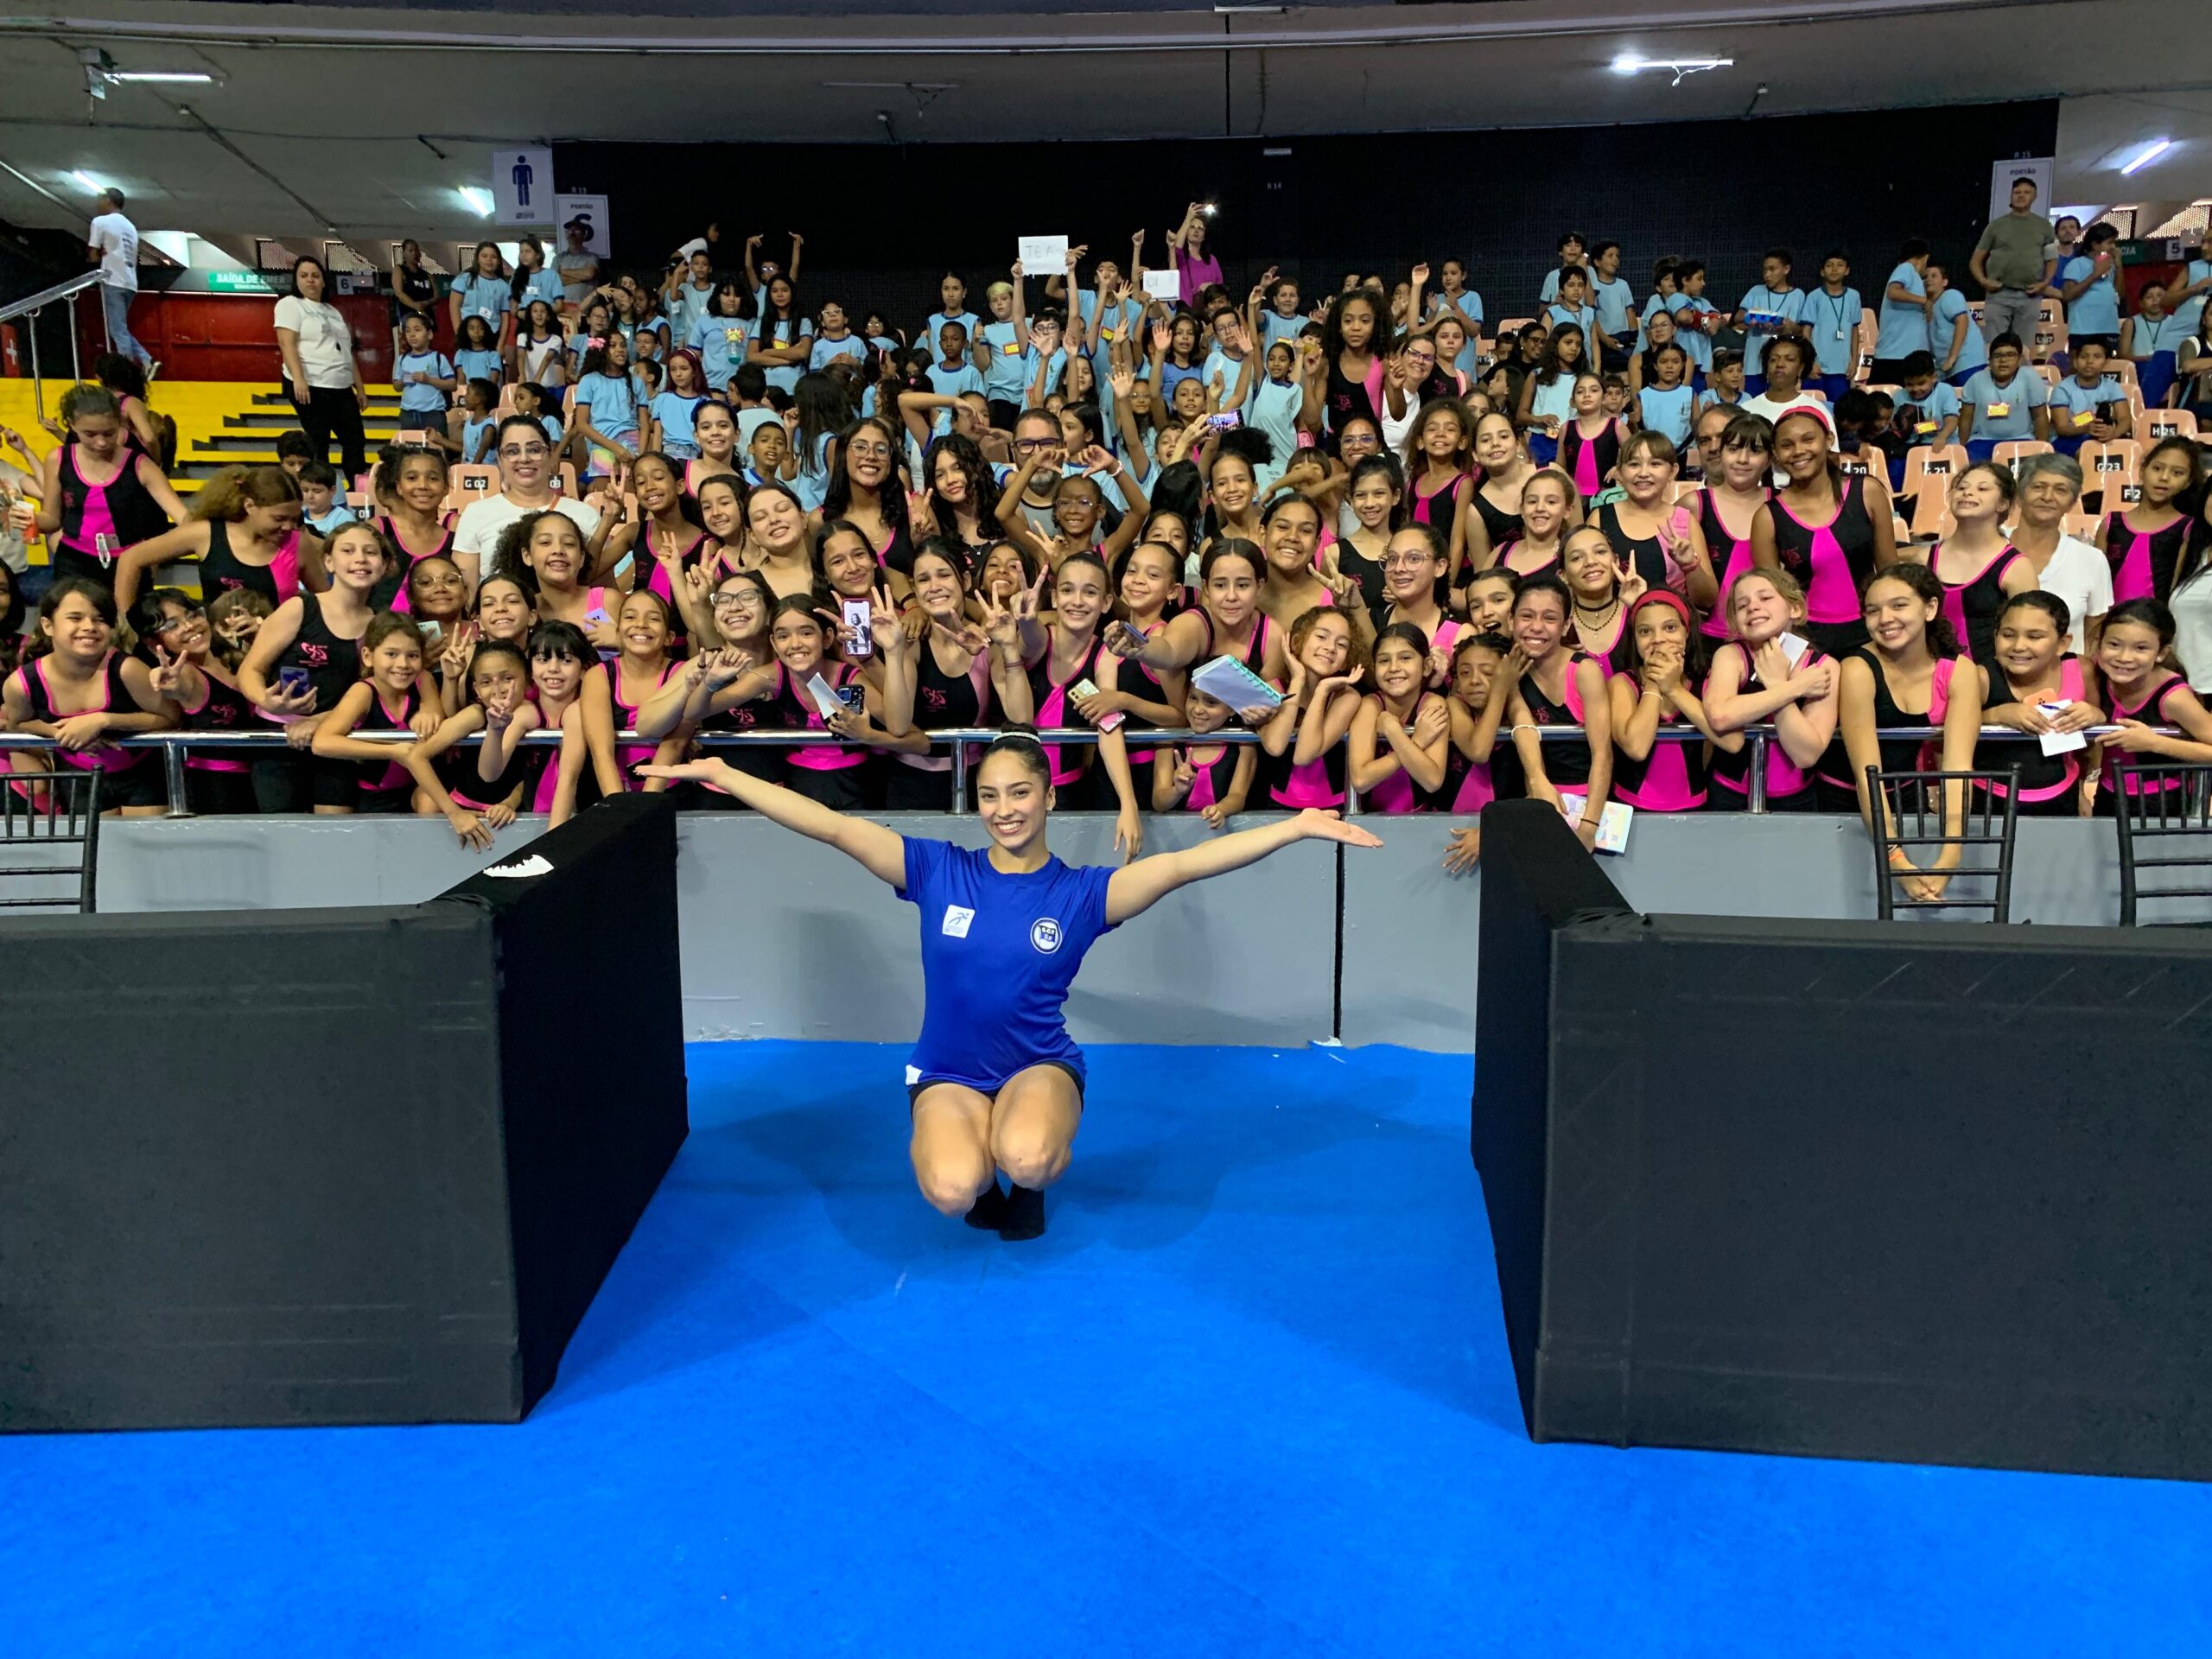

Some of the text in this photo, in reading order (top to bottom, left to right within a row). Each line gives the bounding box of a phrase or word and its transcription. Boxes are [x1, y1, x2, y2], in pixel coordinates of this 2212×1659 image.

[2010, 167, 2037, 175] PORTÃO
[2171, 242, 2180, 254] 5
[216, 271, 244, 283] SAÍDA
[245, 274, 257, 283] DE
[340, 278, 349, 289] 6
[2152, 427, 2176, 436] H 25
[2107, 462, 2120, 472] 23
[464, 479, 486, 488] G 02
[2124, 489, 2141, 499] F 2
